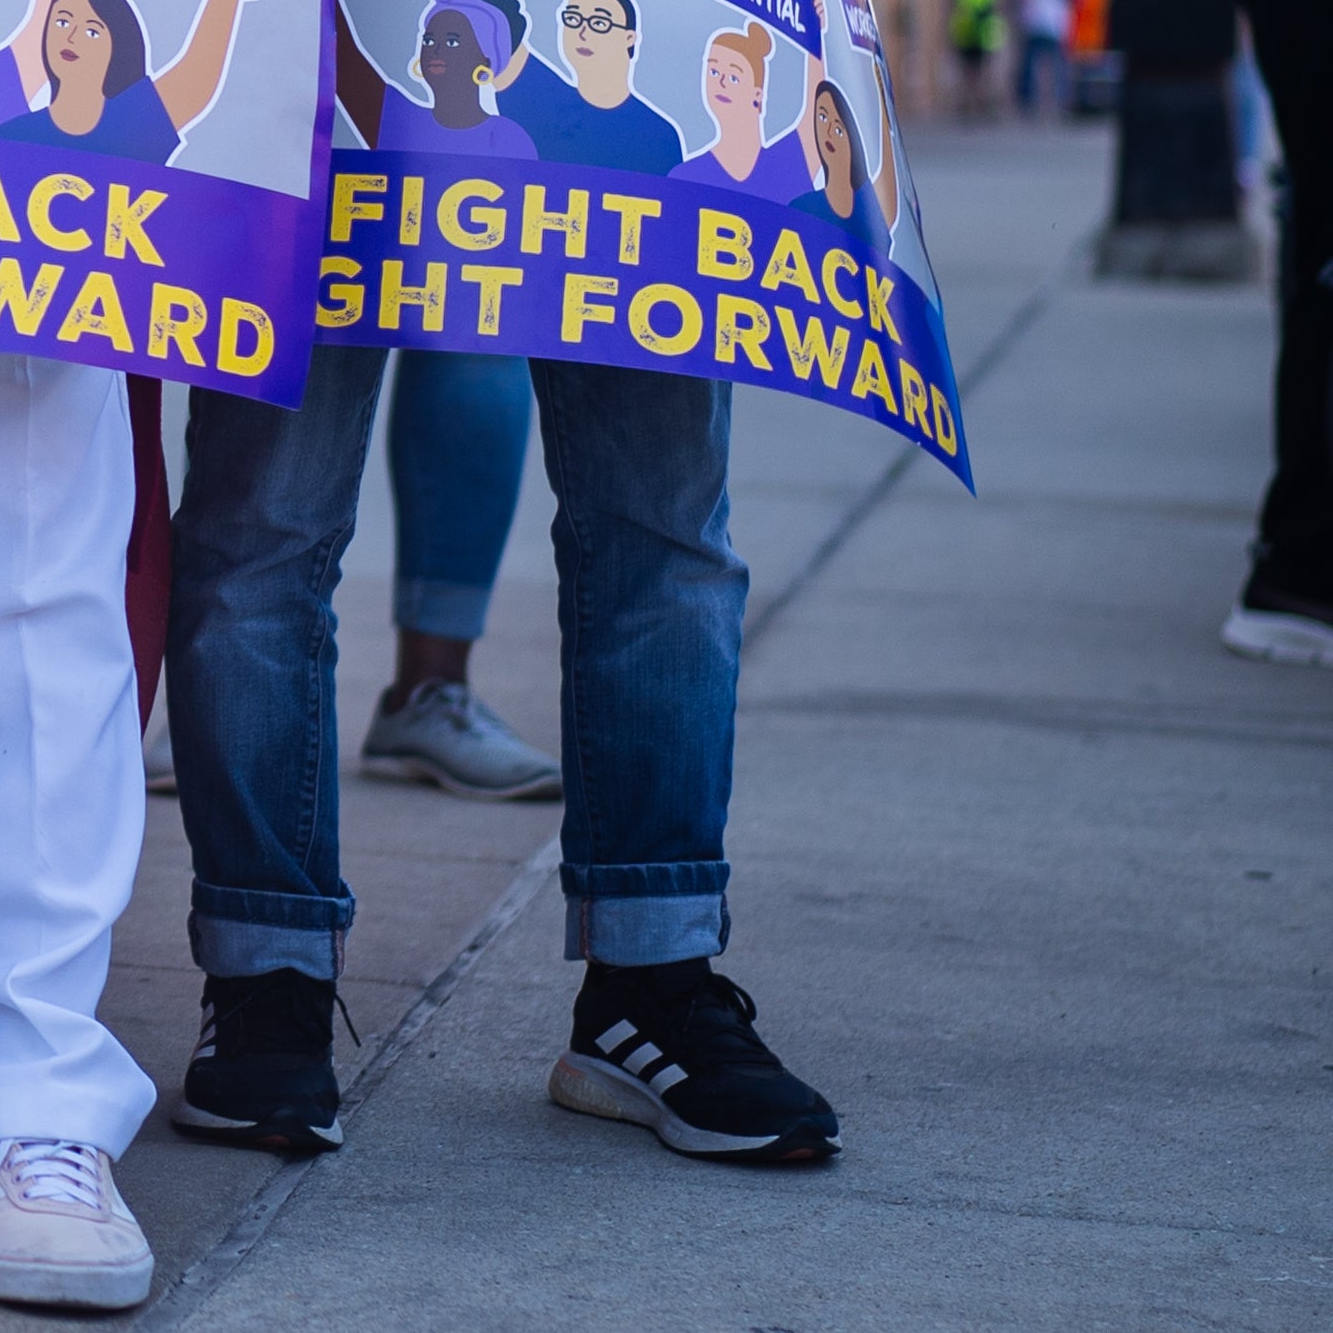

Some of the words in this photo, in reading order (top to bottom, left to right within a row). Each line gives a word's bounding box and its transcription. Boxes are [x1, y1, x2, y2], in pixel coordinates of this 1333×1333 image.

[330, 173, 662, 265] FIGHT
[697, 208, 901, 343] BACK
[315, 259, 523, 335] GHT
[561, 273, 957, 456] FORWARD
